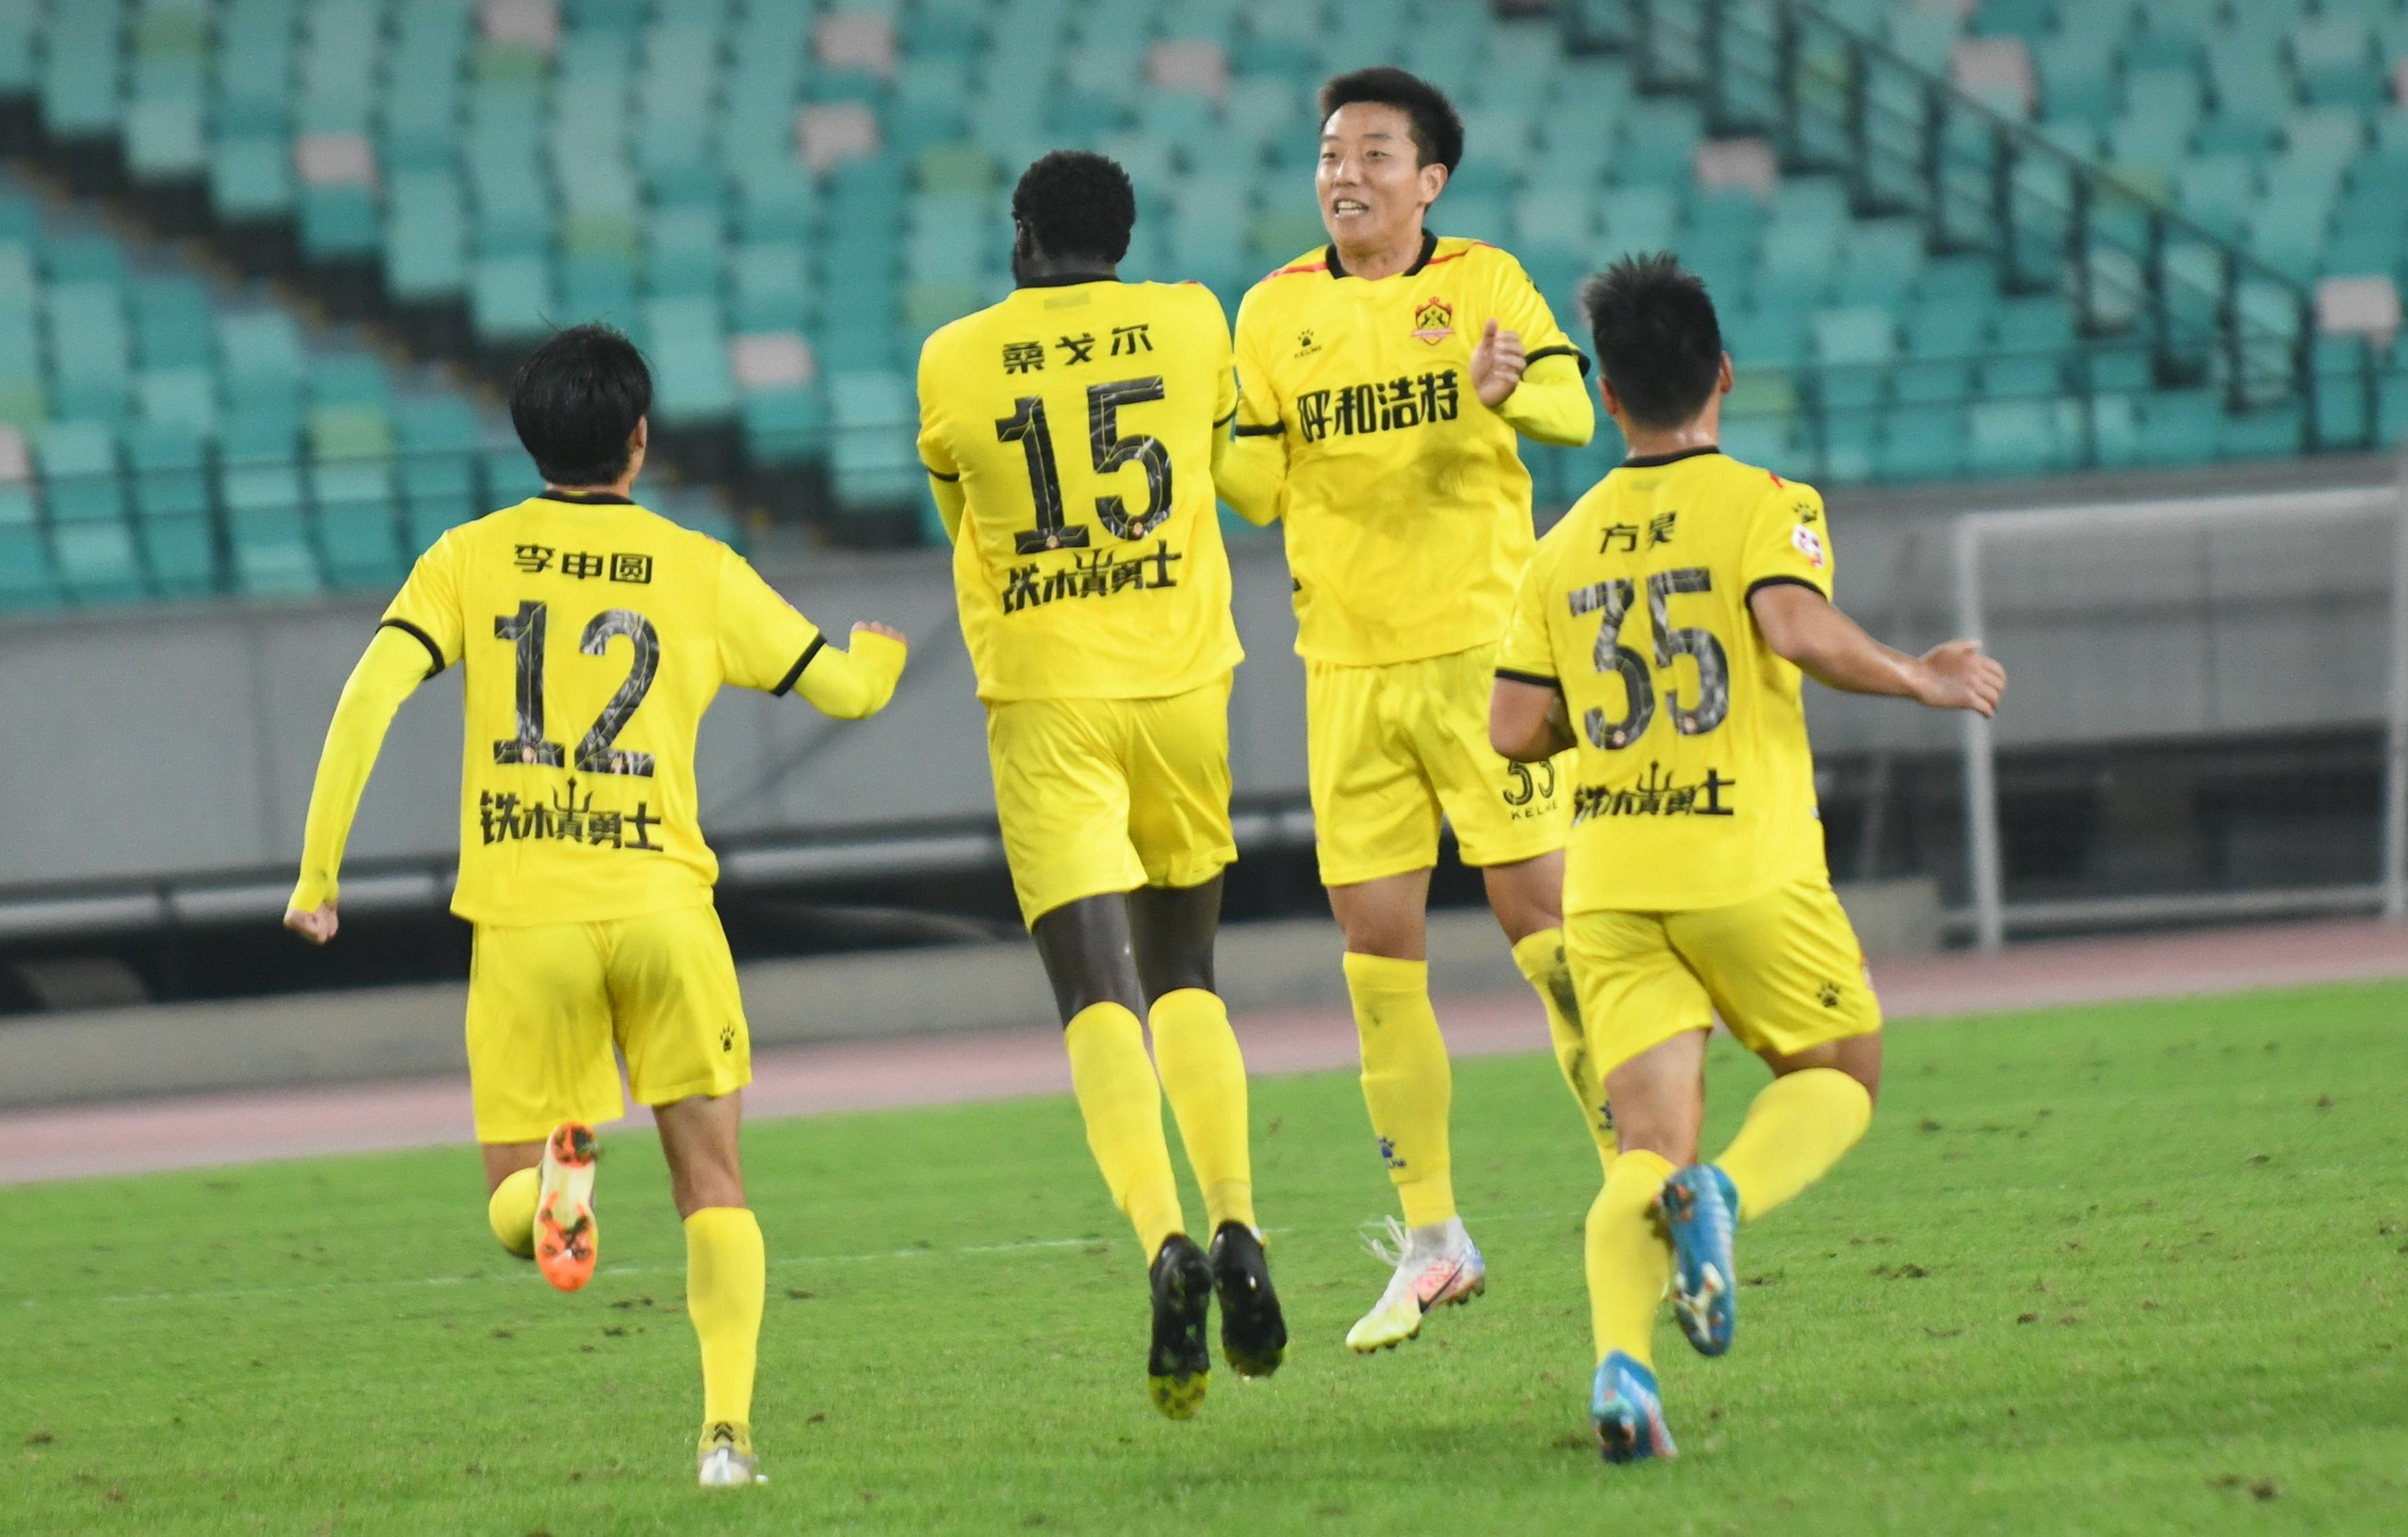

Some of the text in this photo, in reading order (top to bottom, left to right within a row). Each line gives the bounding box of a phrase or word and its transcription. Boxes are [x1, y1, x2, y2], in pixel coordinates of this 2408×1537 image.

[1002, 324, 1154, 375] 桑戈尔
[1297, 369, 1459, 445] 呼和浩特
[995, 375, 1173, 554] 15
[515, 543, 653, 585] 李申圆
[493, 600, 660, 778] 12
[1568, 567, 1730, 751] 35
